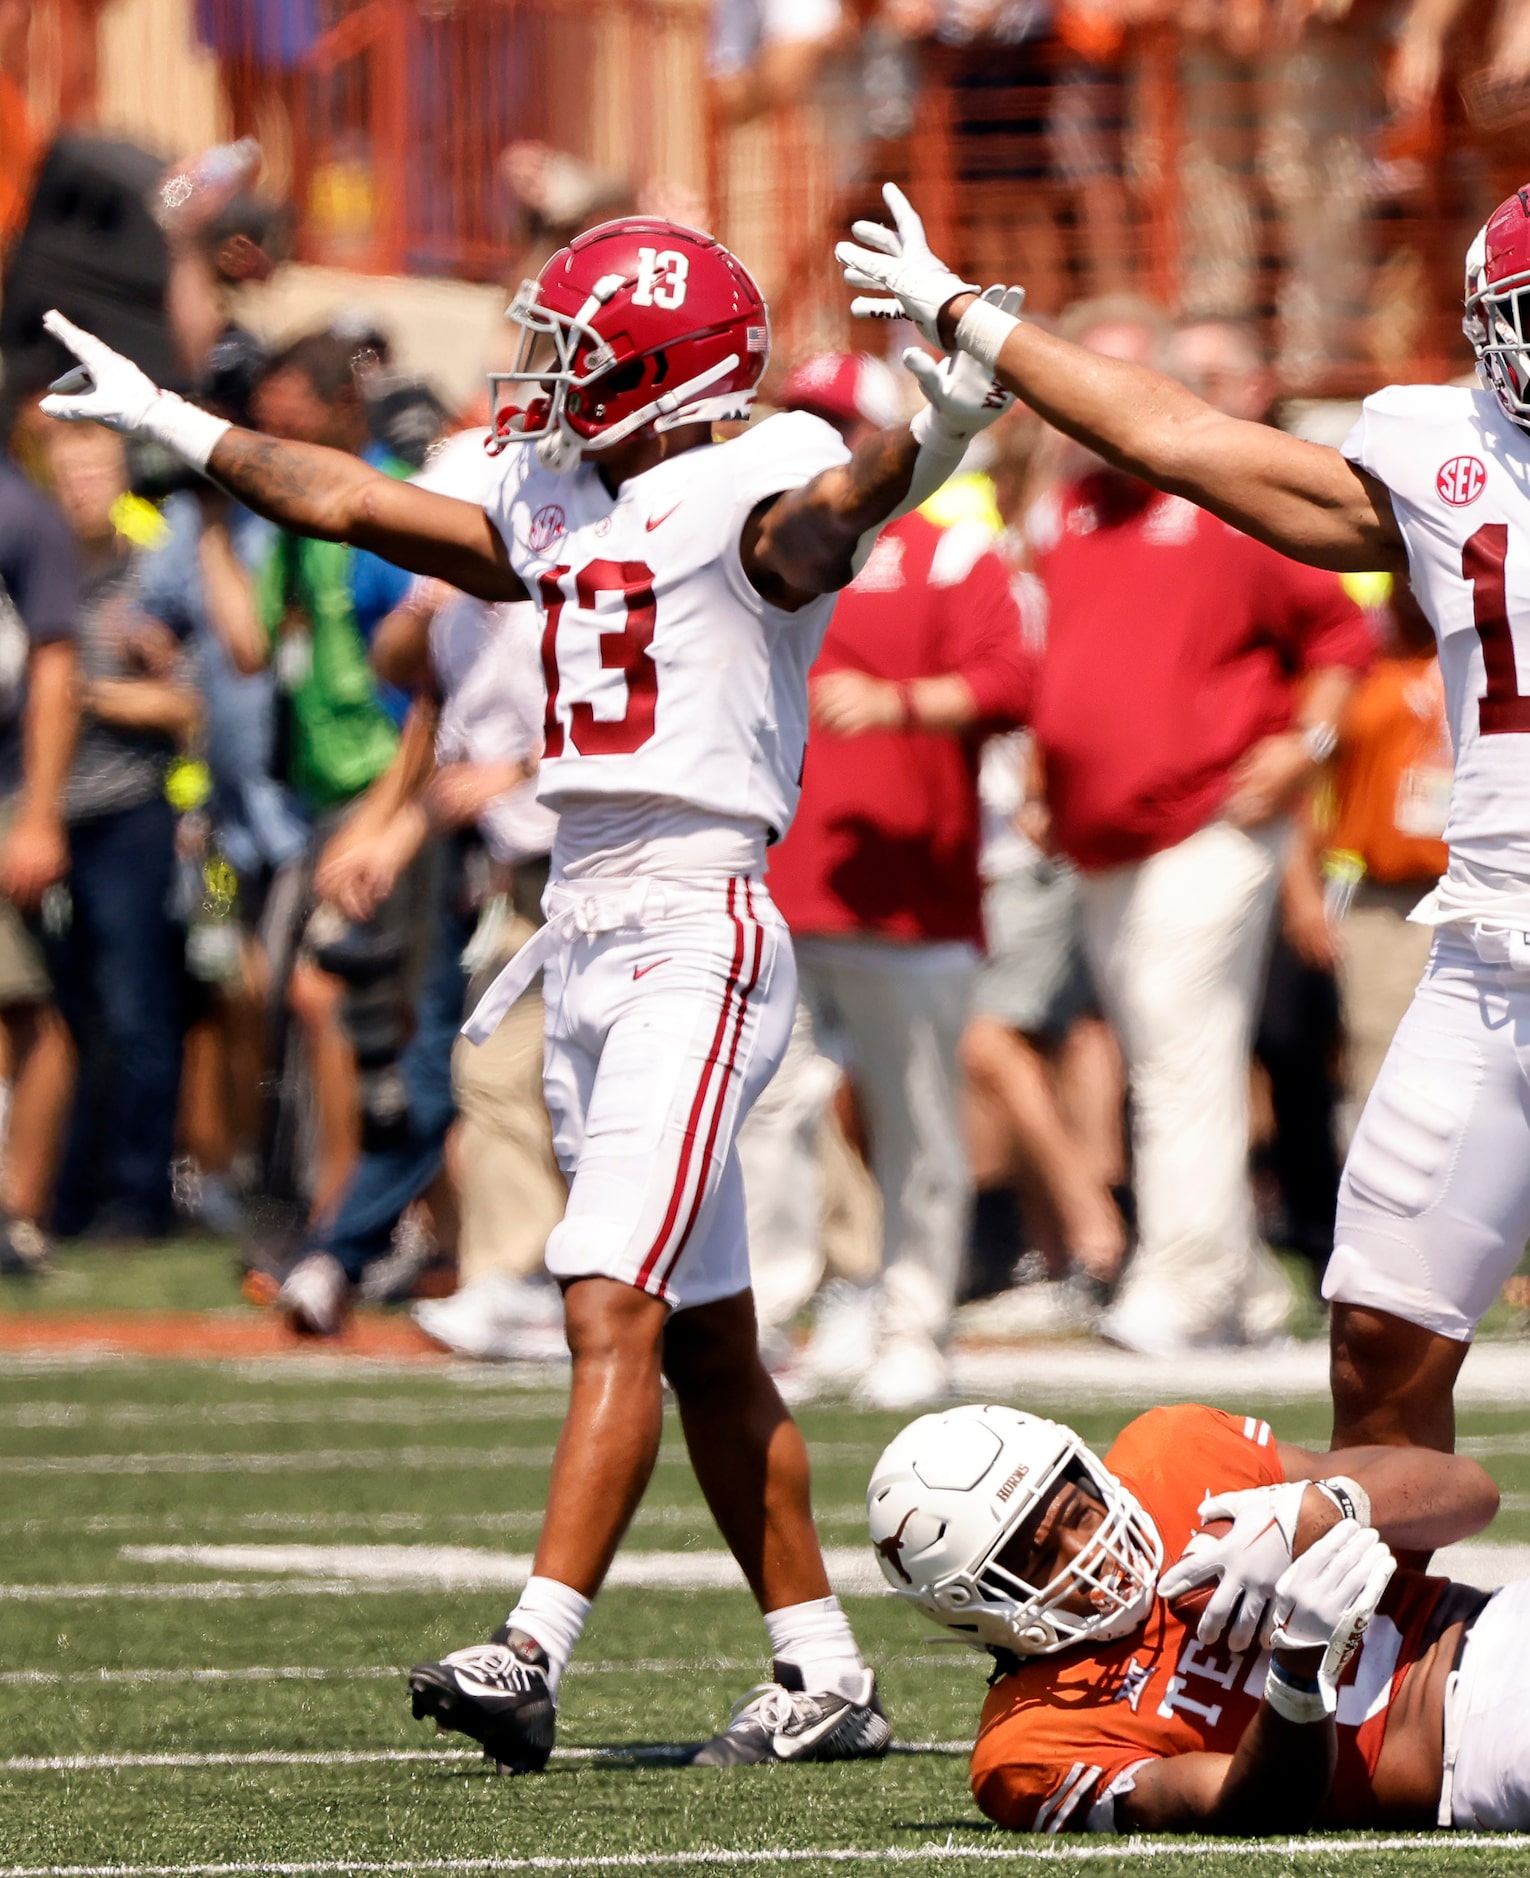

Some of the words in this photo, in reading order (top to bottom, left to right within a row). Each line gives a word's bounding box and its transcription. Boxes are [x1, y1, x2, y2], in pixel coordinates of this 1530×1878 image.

[631, 247, 689, 311] 13
[1437, 456, 1486, 505] SEC
[537, 558, 658, 758] 13
[996, 1463, 1030, 1503] HORNS
